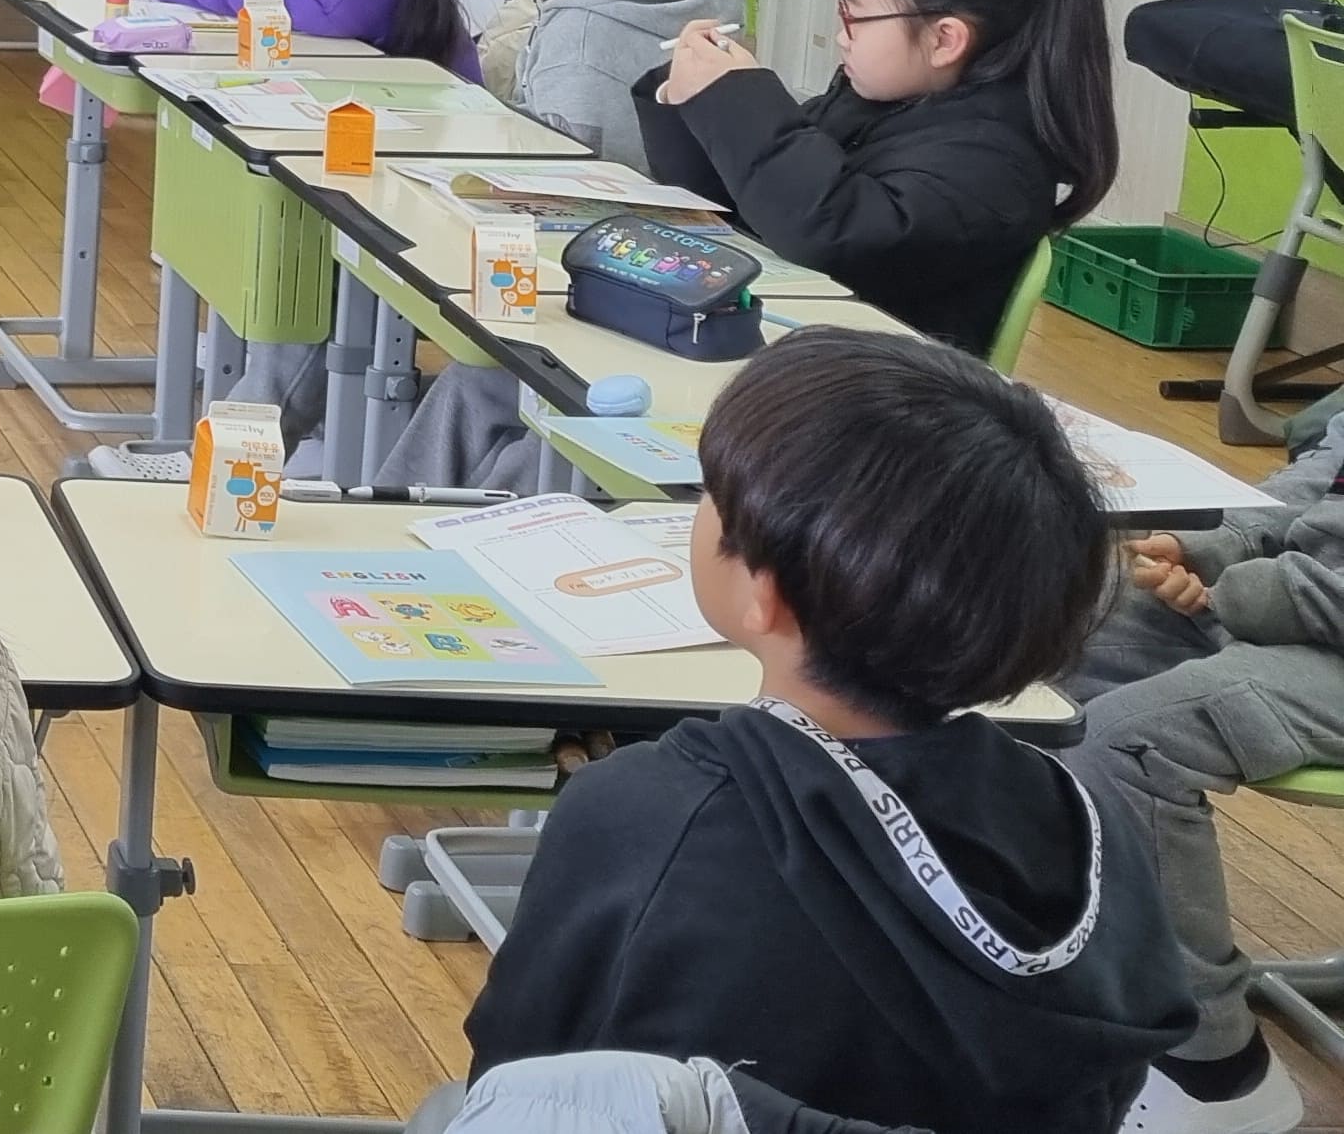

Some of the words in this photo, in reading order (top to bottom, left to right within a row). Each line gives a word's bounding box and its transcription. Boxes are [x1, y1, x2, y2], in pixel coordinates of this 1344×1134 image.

[321, 570, 427, 582] ENGLISH
[871, 791, 945, 887] PARIS
[952, 905, 1052, 975] PARIS
